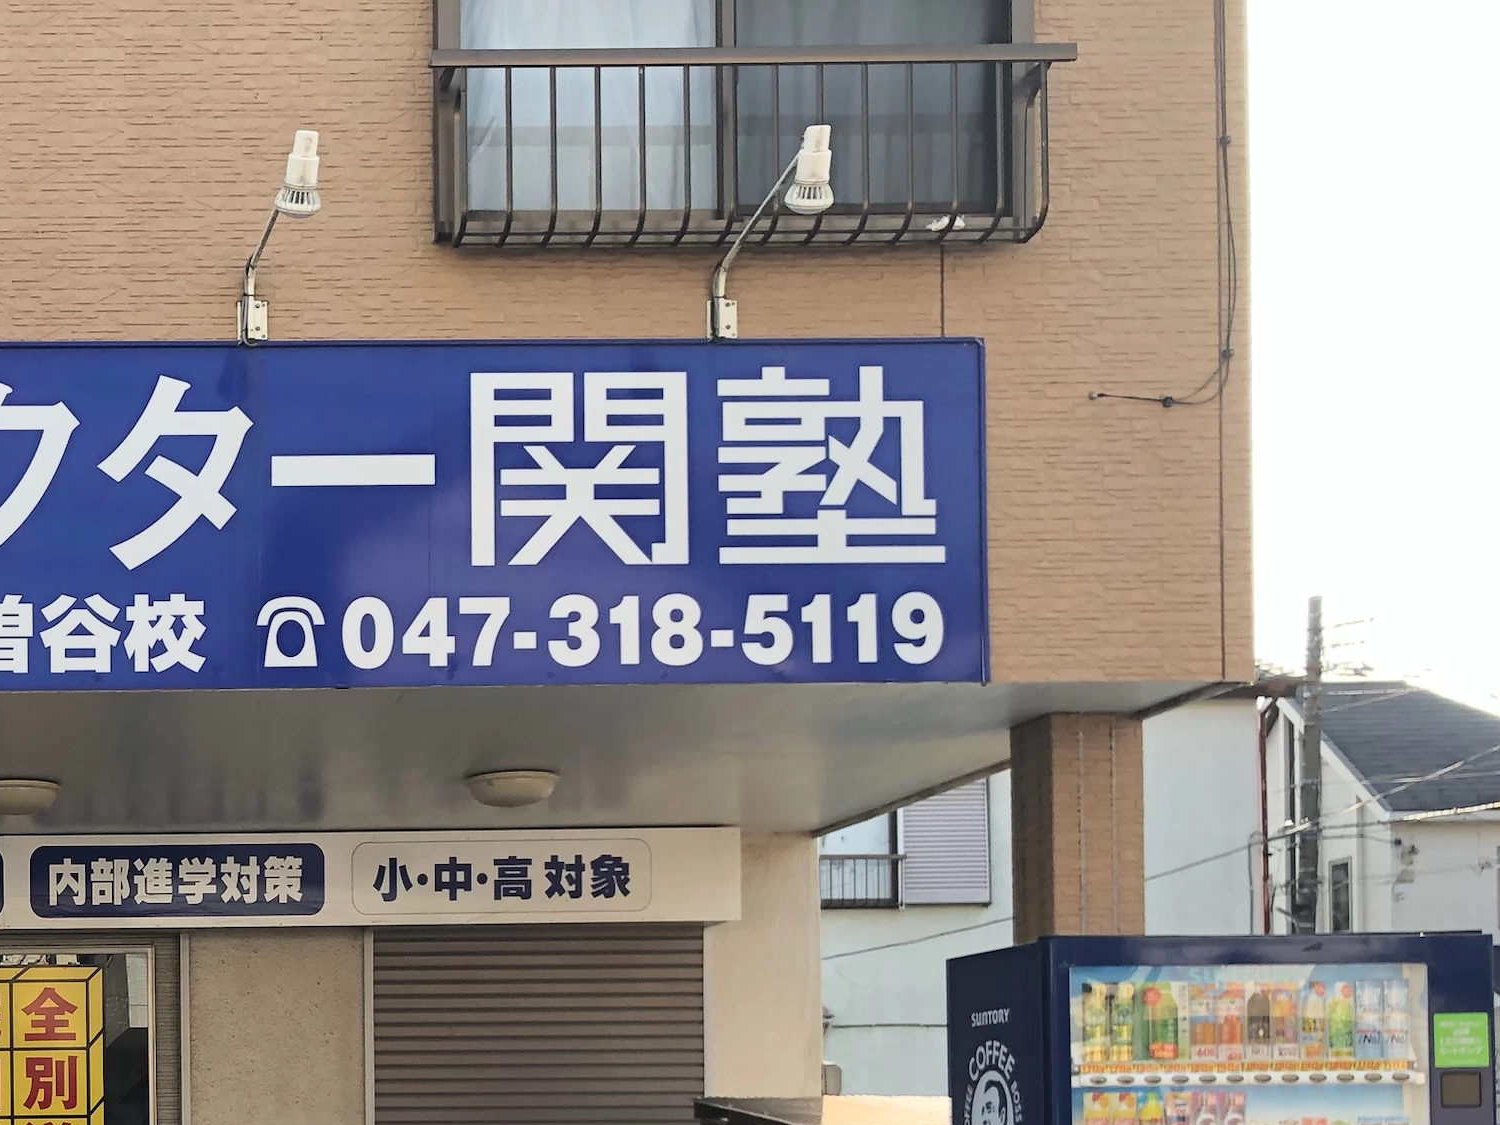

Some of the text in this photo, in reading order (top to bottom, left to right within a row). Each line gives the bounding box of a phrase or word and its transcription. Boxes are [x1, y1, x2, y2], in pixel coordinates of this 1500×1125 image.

[342, 592, 945, 670] 047-318-5119
[46, 857, 305, 907] 内部進学対策
[971, 1008, 1010, 1027] SUNTORY
[969, 1040, 1015, 1081] COFFEE
[1011, 1080, 1023, 1123] BOSS
